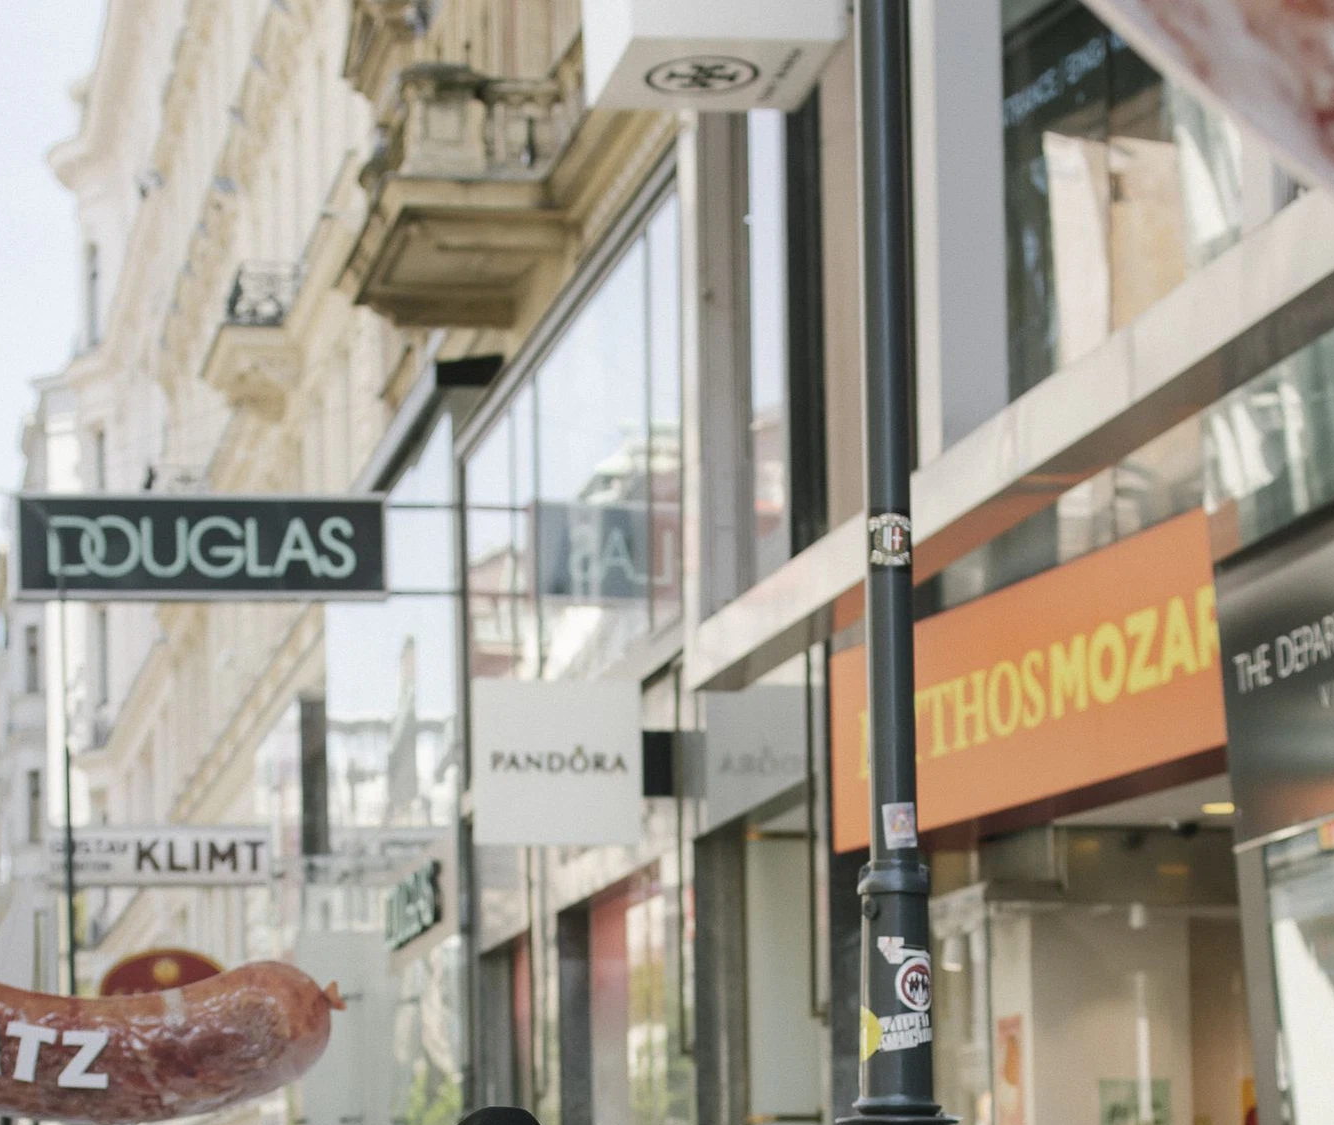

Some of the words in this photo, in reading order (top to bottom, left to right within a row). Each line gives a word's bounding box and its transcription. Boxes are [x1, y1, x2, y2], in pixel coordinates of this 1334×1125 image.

[46, 514, 356, 580] DOUGLAS
[858, 583, 1221, 780] THOSMOZAR
[1232, 643, 1273, 694] THE
[489, 746, 628, 776] PANDORA
[134, 839, 266, 874] KLIMT
